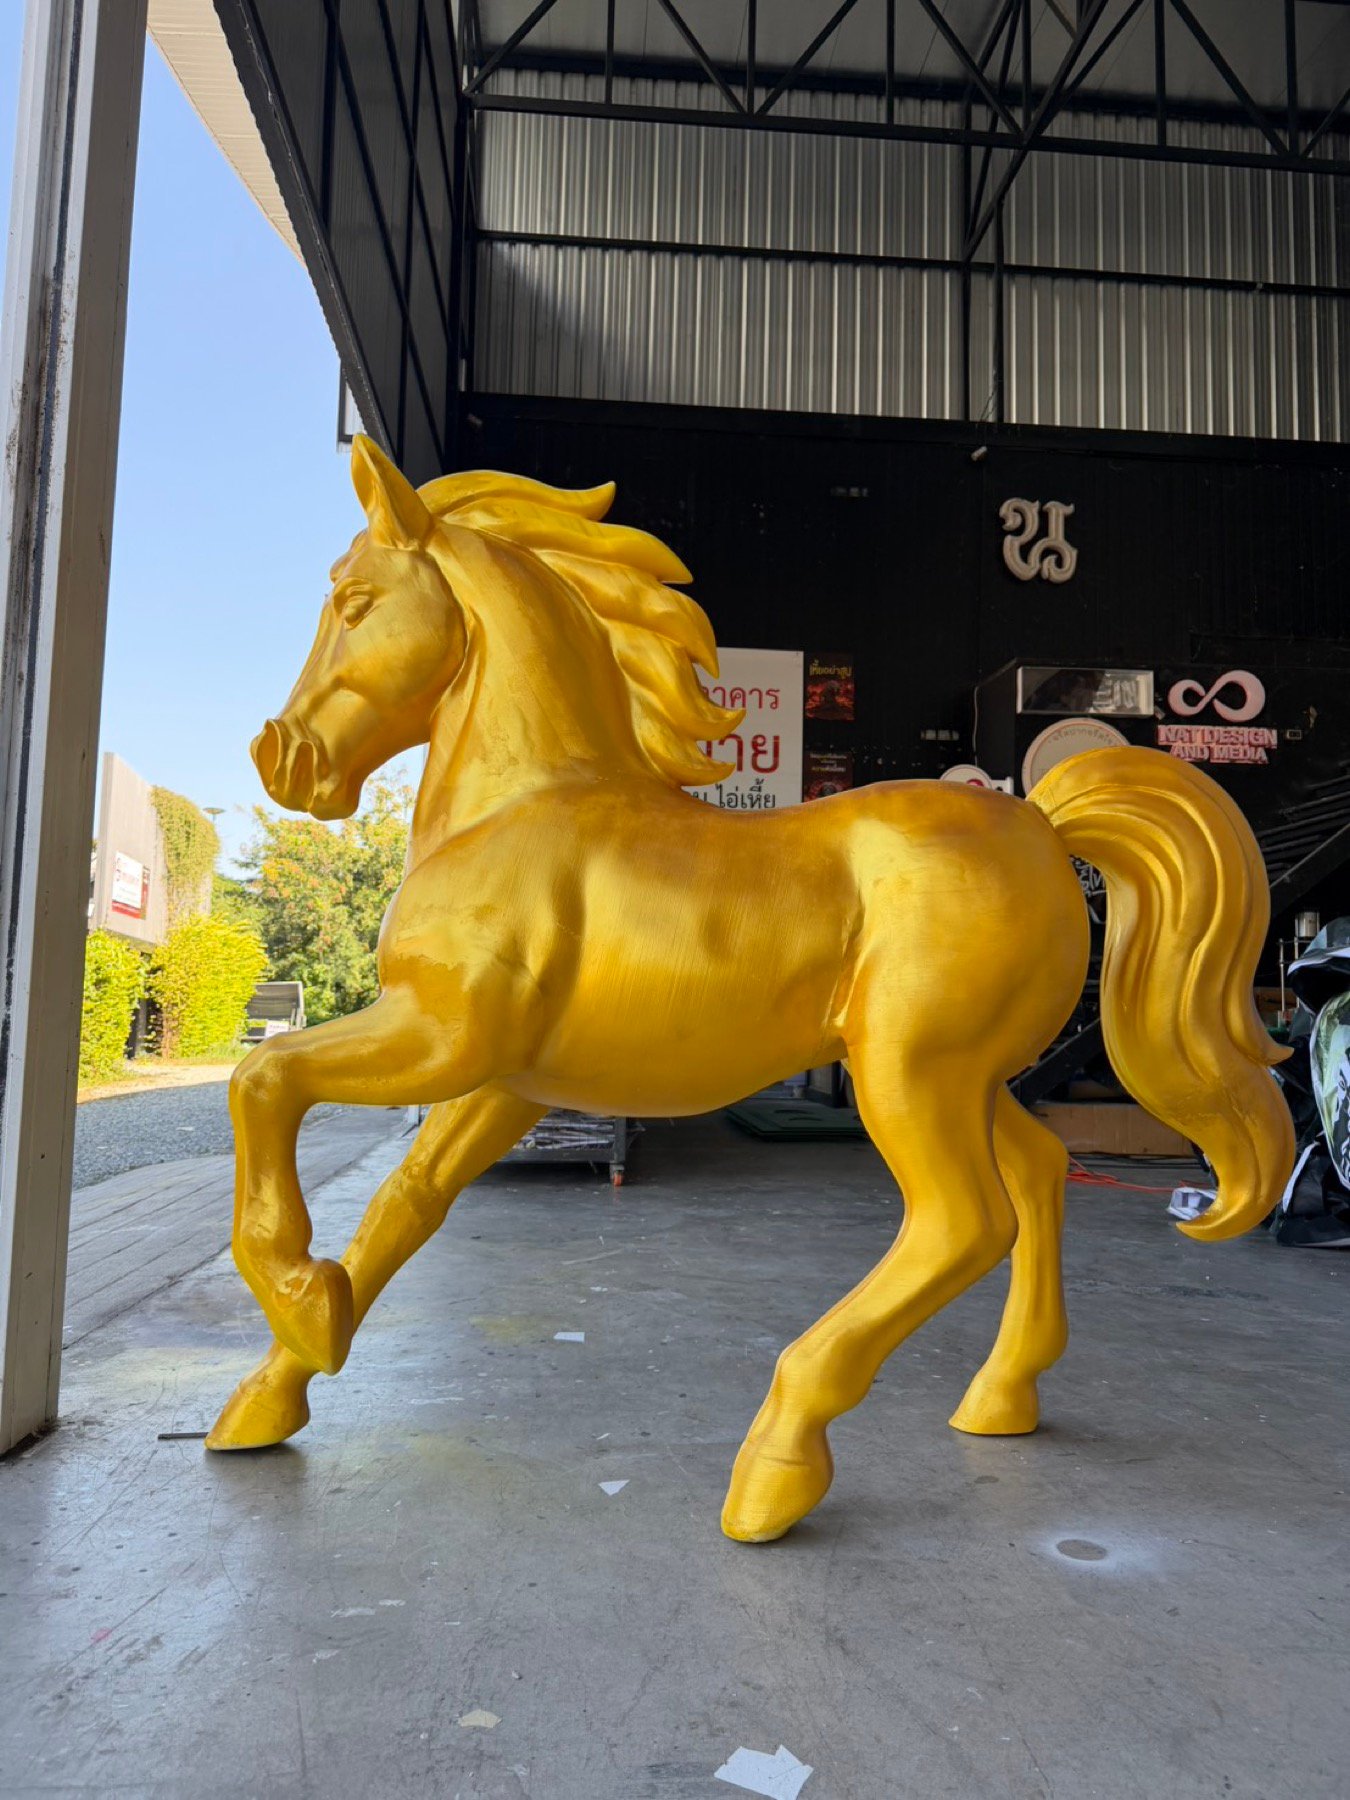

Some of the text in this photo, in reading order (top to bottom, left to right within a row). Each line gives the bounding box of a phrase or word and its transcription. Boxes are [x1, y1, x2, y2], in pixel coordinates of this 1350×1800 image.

[1158, 725, 1278, 748] NAT DESIGN
[705, 733, 780, 774] าย
[1170, 744, 1269, 764] AND MEDIA
